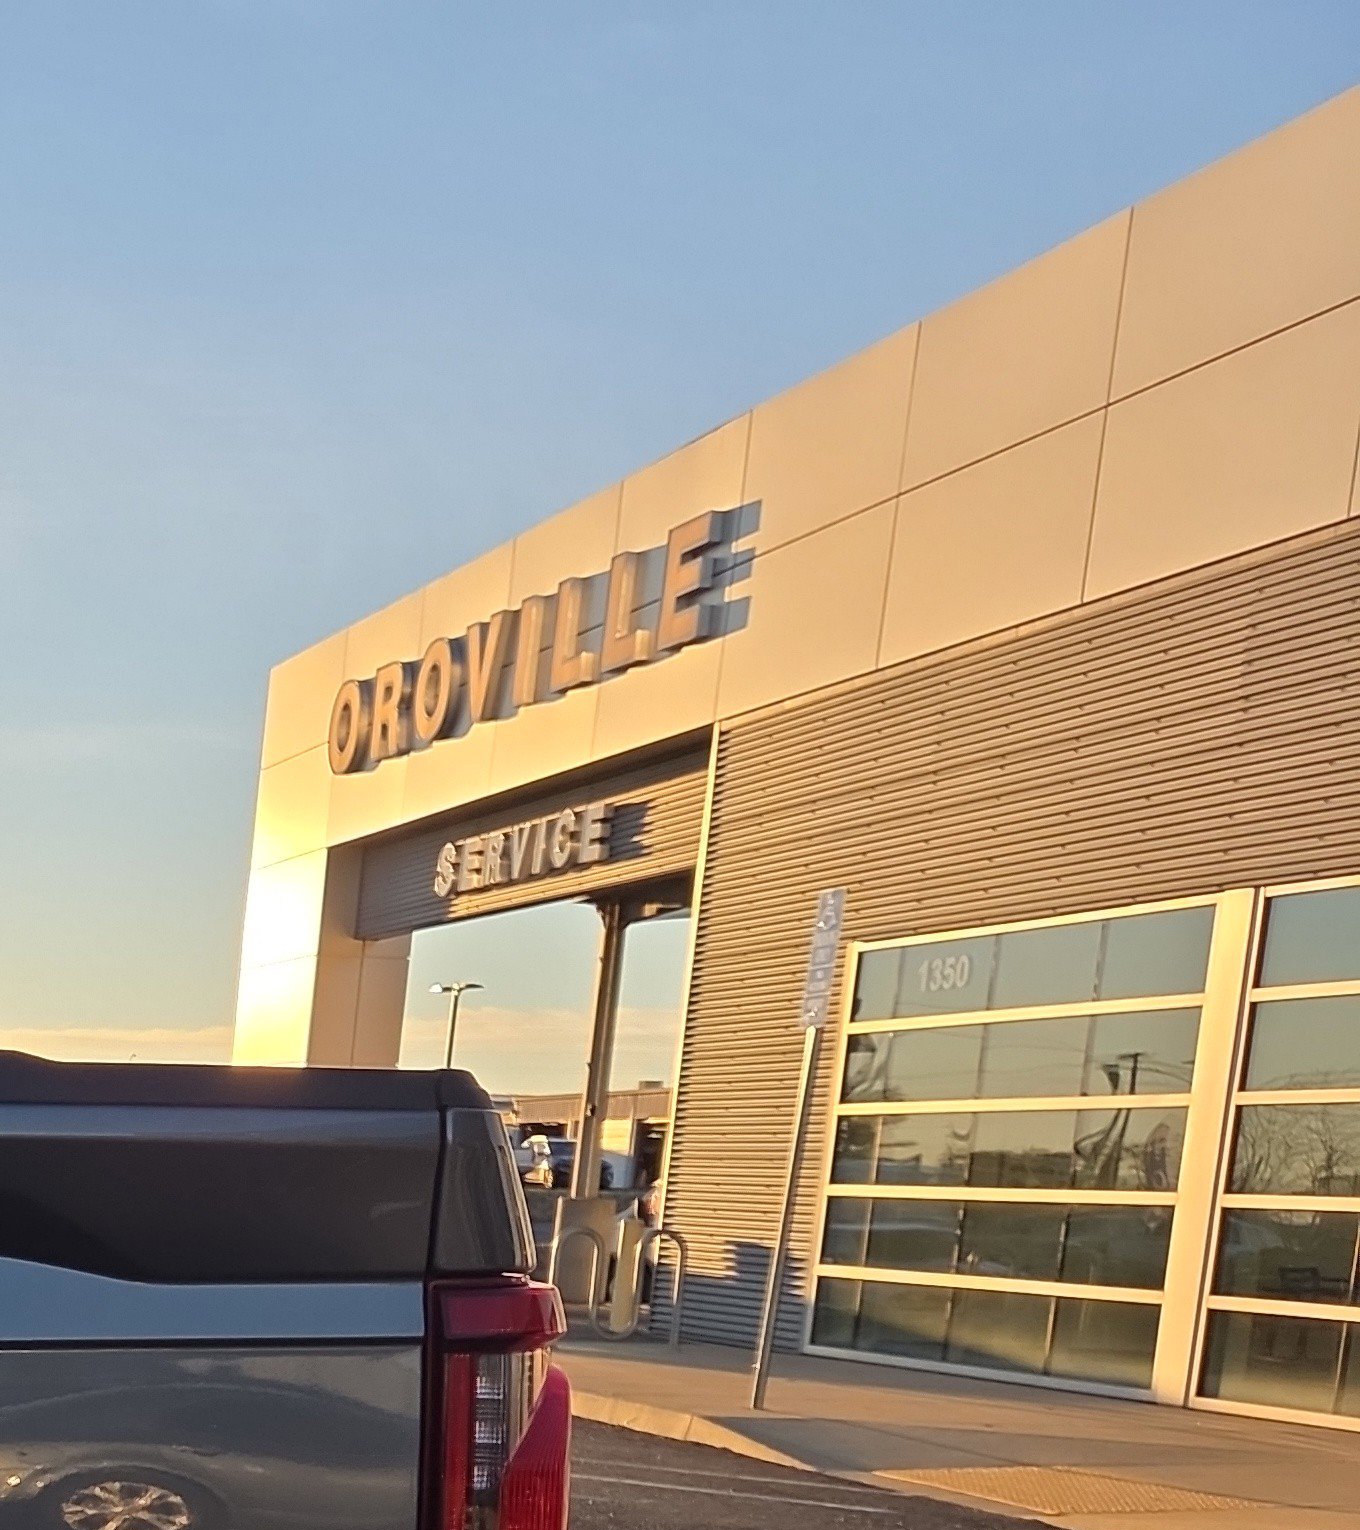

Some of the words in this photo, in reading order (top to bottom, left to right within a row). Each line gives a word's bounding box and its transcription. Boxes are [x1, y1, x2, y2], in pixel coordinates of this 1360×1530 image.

[327, 507, 722, 776] OROVILLE
[434, 801, 615, 898] SERVICE
[918, 954, 971, 993] 1350
